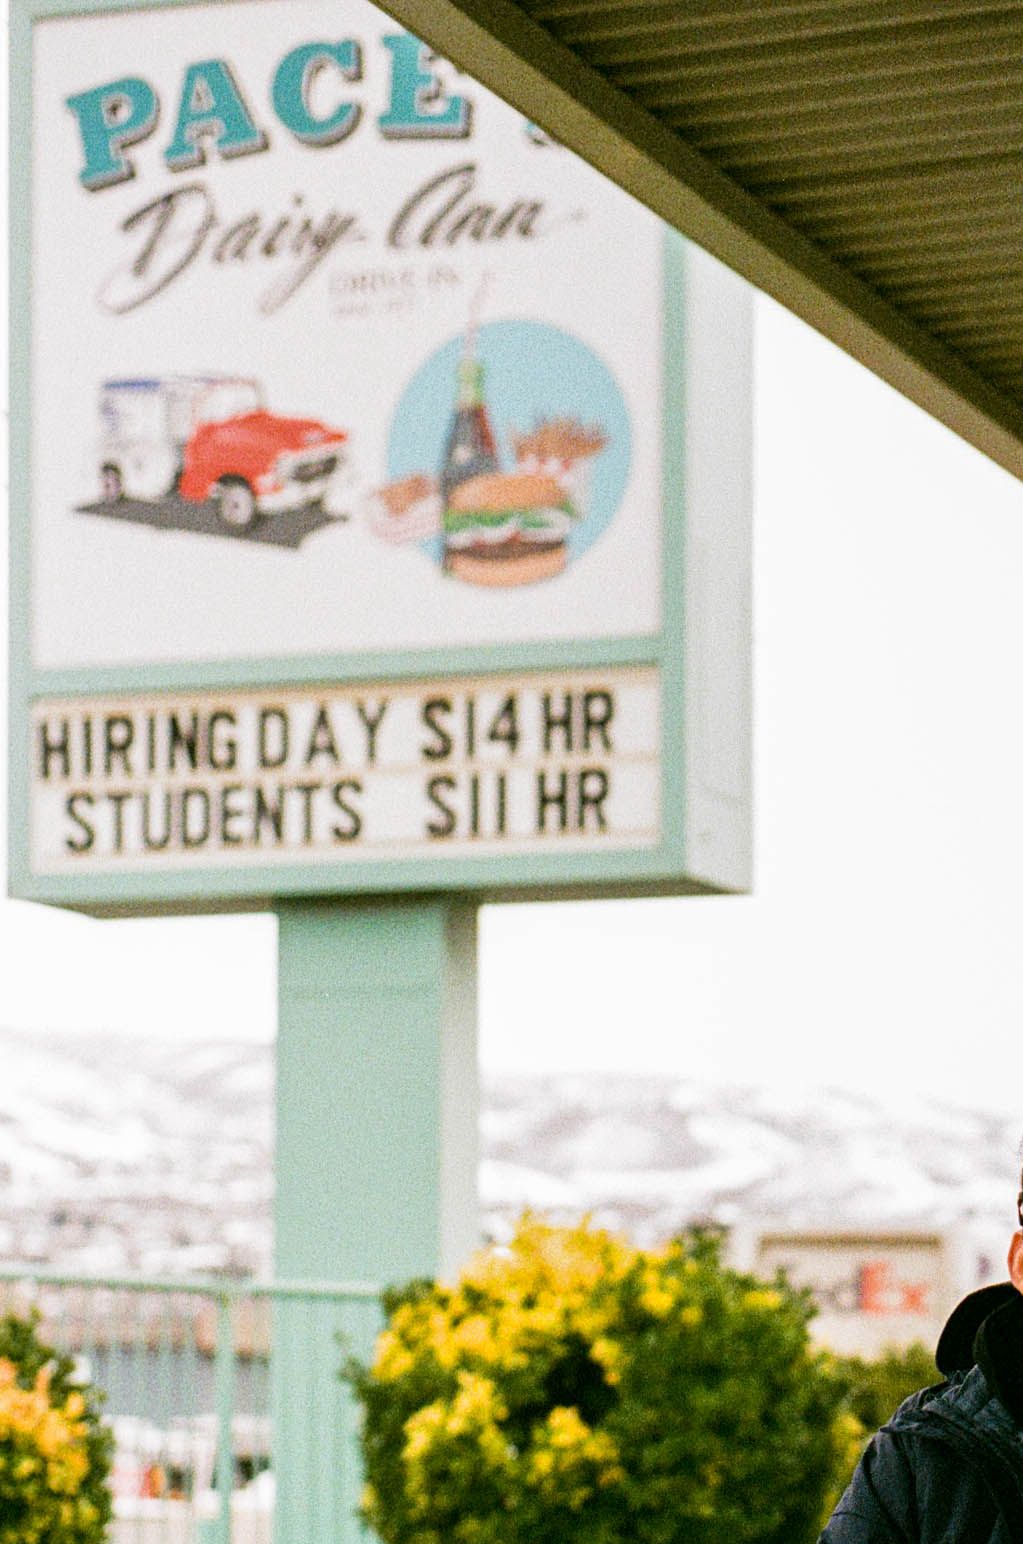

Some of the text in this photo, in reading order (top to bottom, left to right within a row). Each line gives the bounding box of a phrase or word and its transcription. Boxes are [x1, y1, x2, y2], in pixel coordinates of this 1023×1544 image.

[387, 161, 545, 250] Ann
[541, 688, 616, 755] HR
[65, 779, 363, 852] STUDENTS
[537, 769, 609, 836] HR
